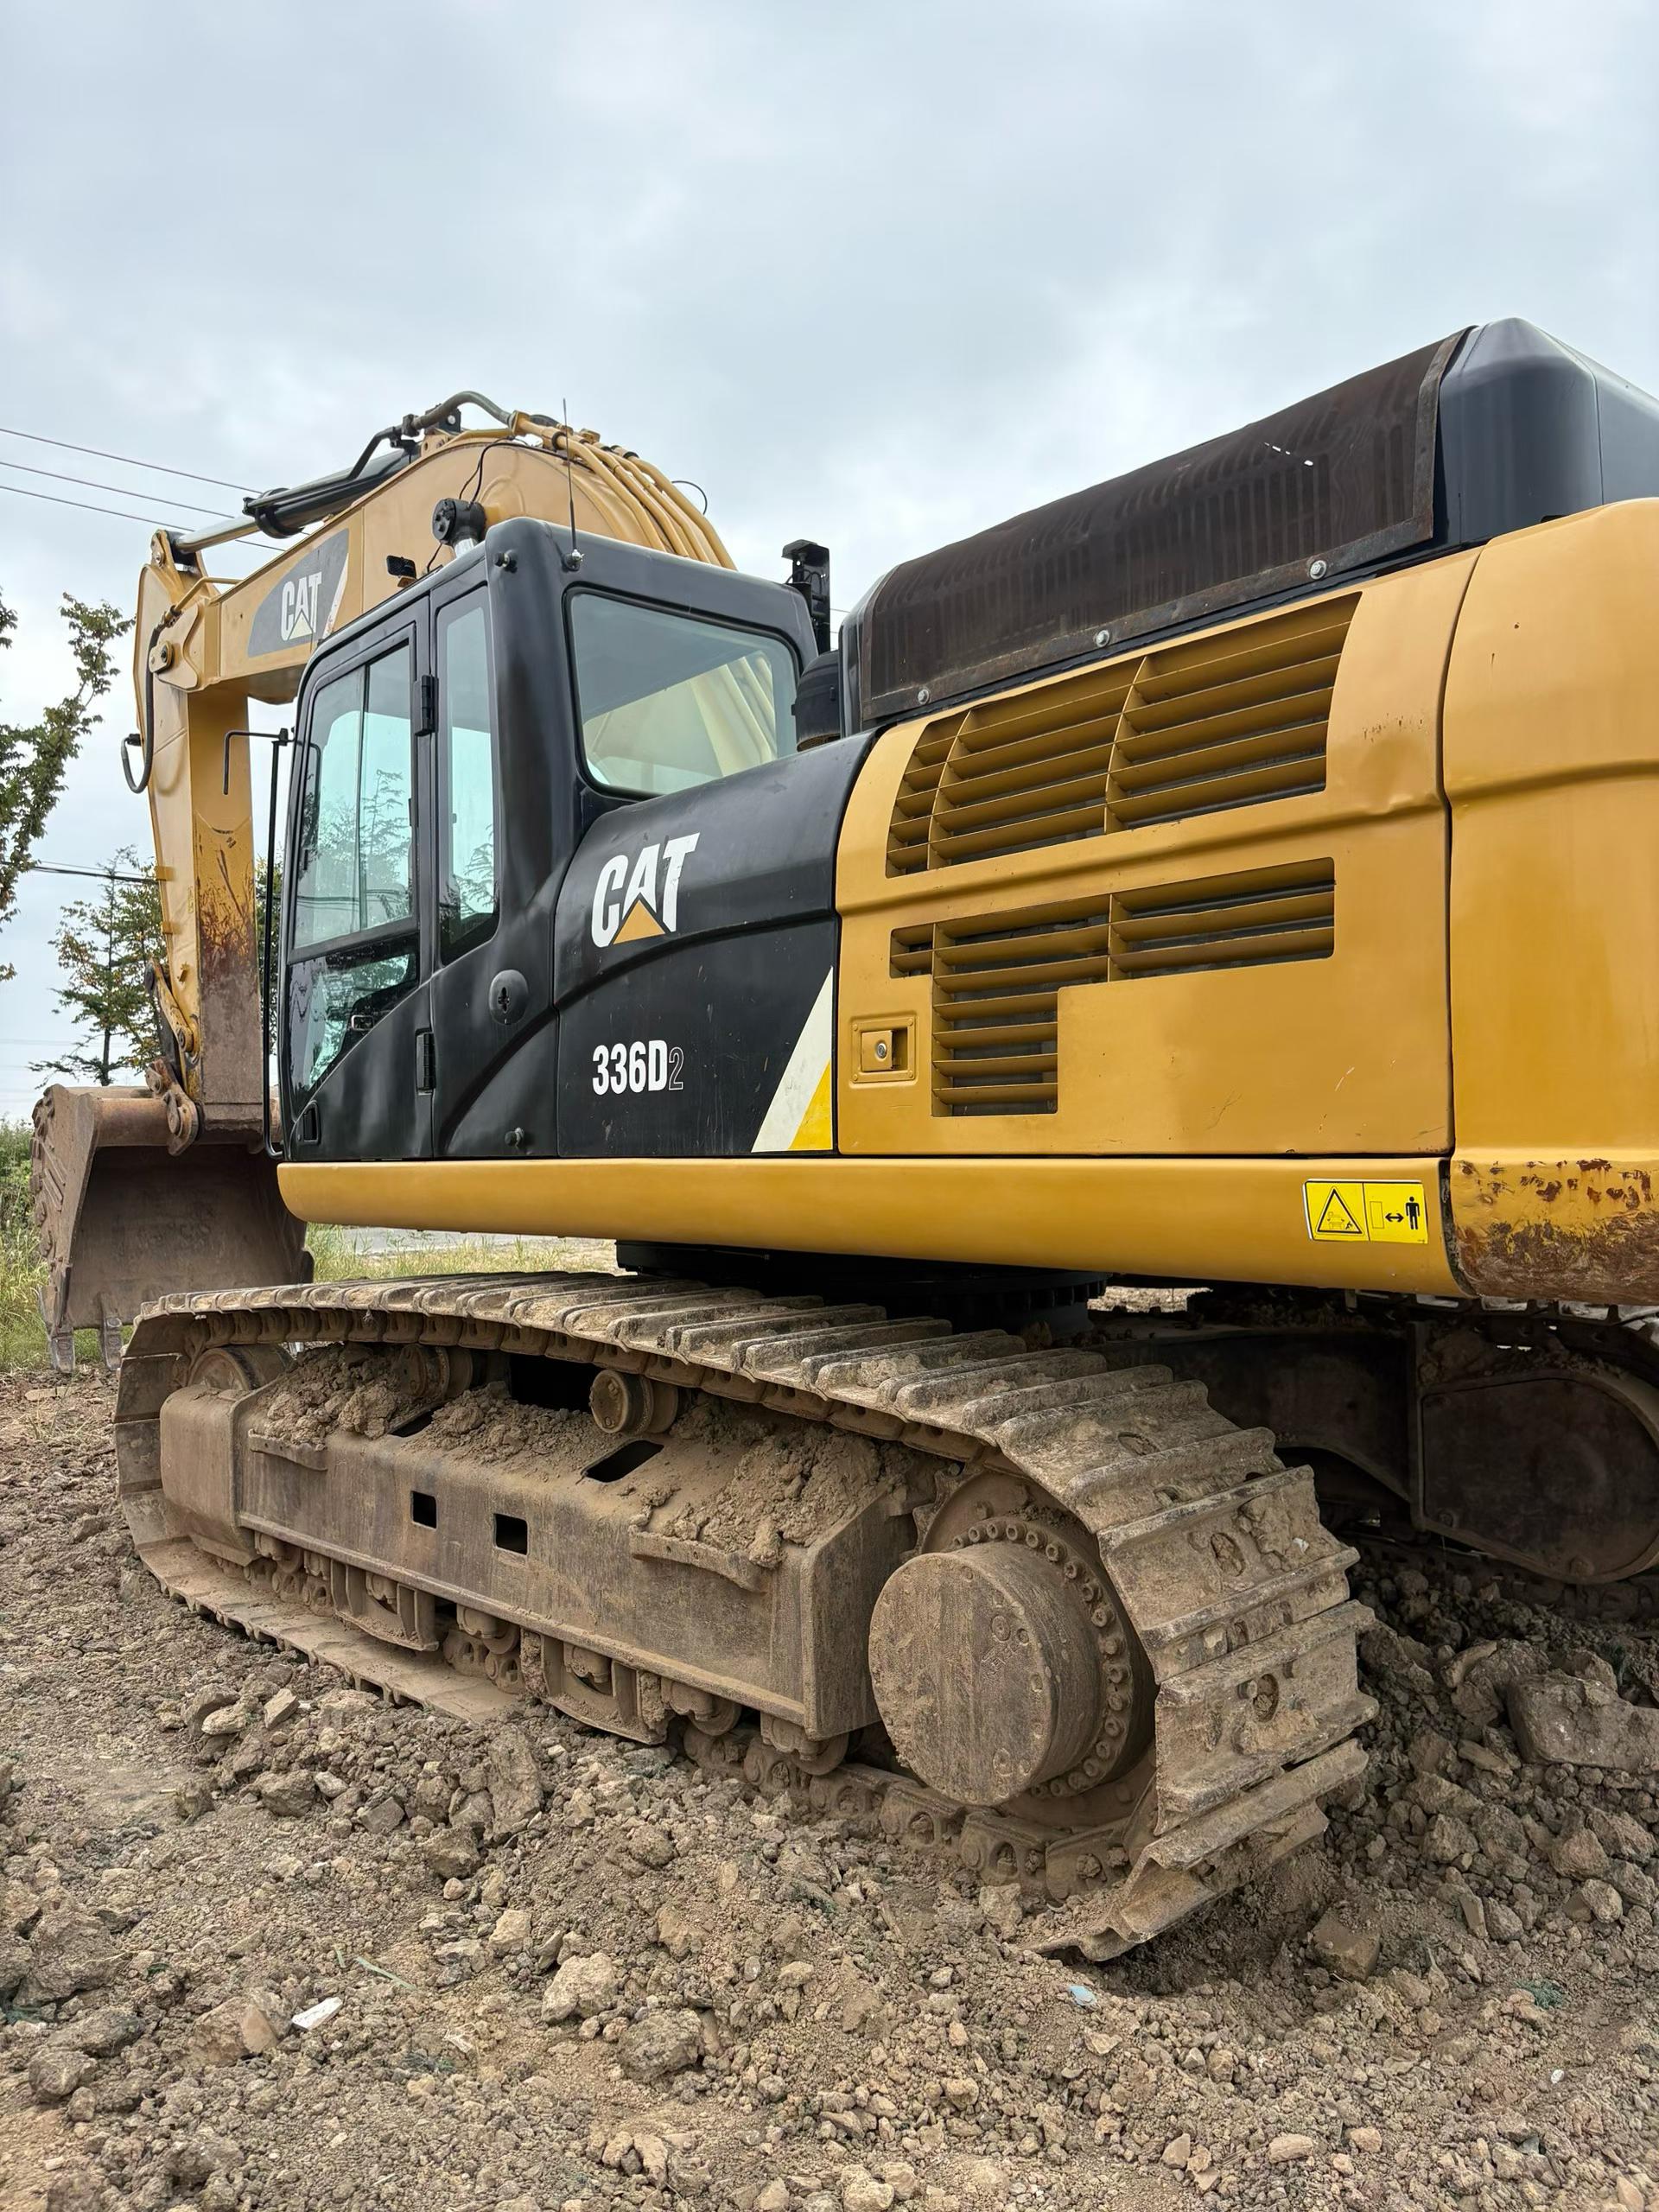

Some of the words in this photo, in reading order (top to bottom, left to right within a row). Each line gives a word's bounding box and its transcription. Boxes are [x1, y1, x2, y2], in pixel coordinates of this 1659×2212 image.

[280, 571, 322, 641] CAT
[591, 832, 701, 948] CAT
[592, 1039, 684, 1095] 336D2
